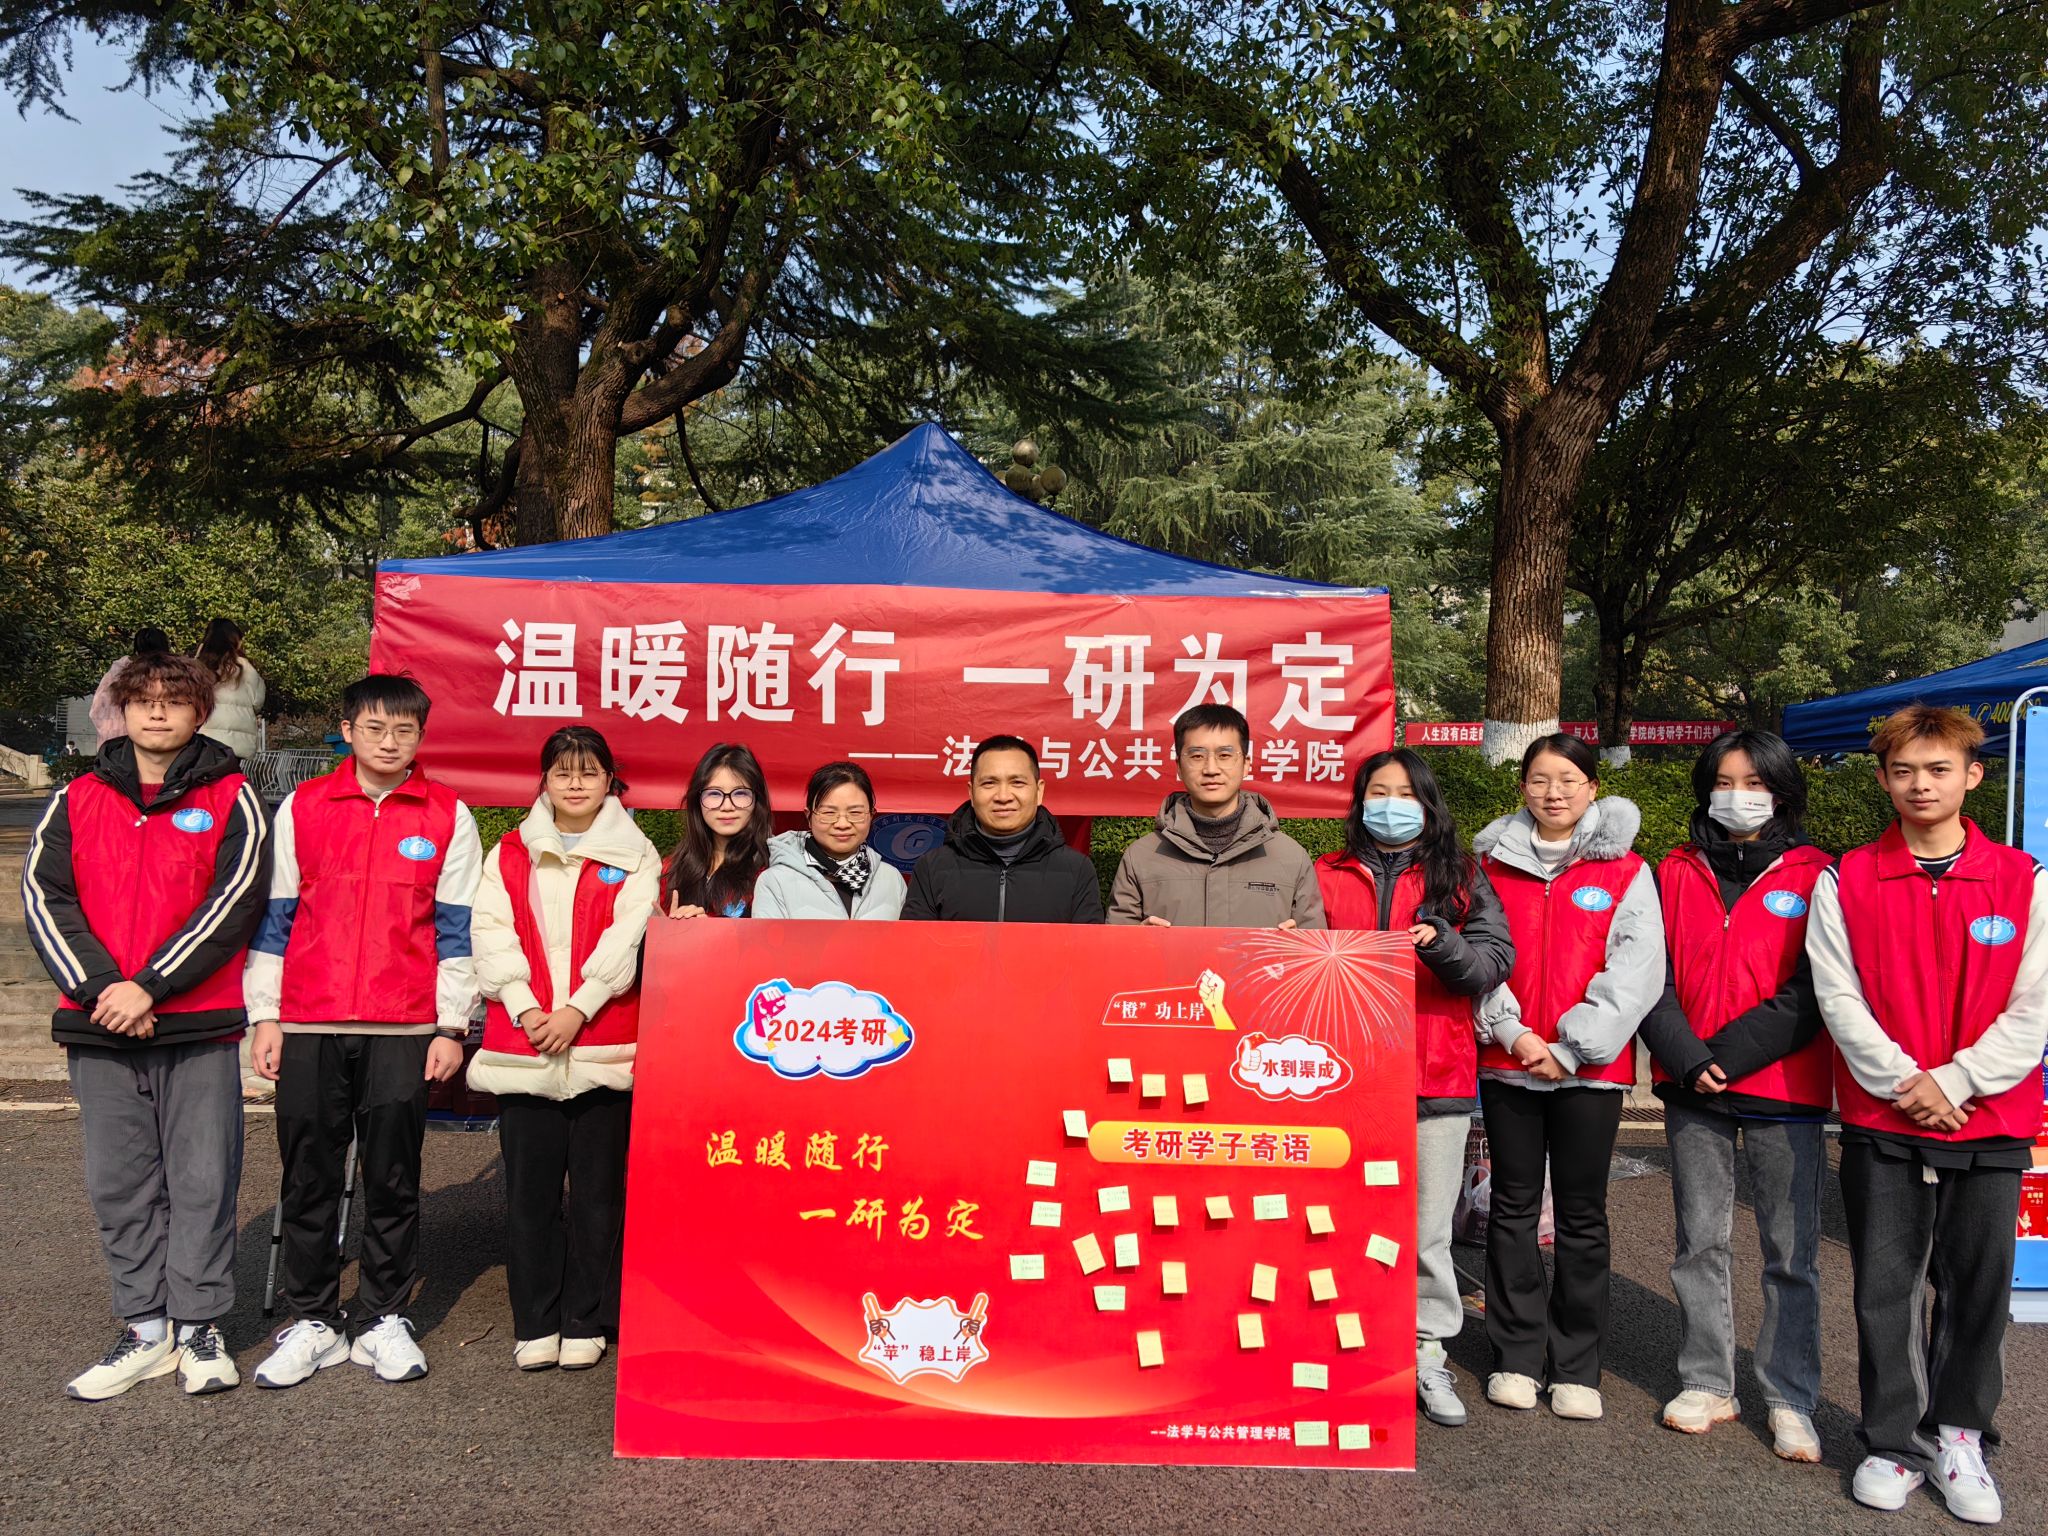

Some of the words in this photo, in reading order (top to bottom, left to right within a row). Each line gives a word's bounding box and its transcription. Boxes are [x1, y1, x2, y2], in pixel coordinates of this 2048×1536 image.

[493, 618, 901, 726] 温暖随行
[963, 631, 1357, 733] 一研为定
[767, 1018, 887, 1046] 2024考研
[1262, 1059, 1335, 1080] 水到渠成
[706, 1130, 890, 1172] 温暖随行
[1122, 1128, 1312, 1163] 考研学子寄语
[799, 1195, 985, 1242] 一研为定
